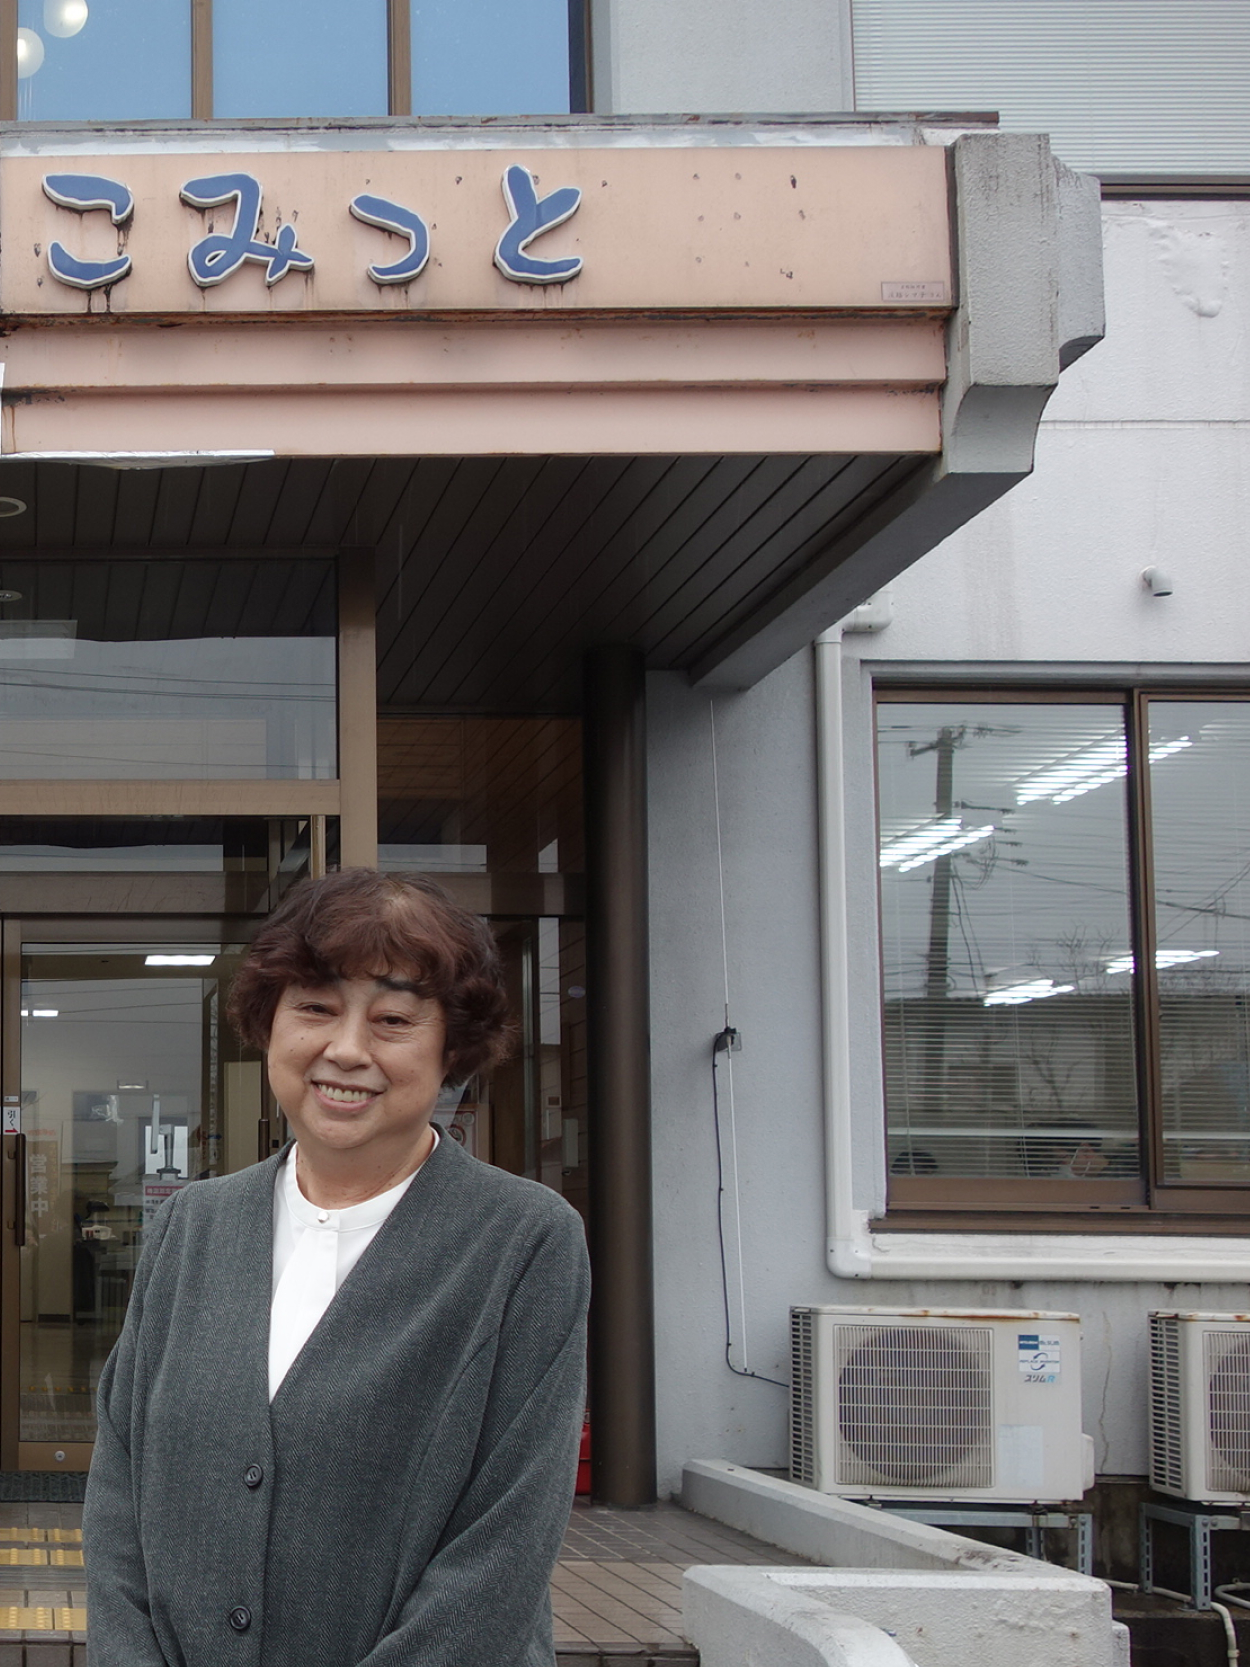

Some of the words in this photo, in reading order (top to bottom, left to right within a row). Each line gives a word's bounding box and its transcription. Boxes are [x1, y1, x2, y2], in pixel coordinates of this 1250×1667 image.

[41, 162, 584, 288] こみっと
[7, 1110, 17, 1127] 引く
[29, 1153, 49, 1218] 営業中
